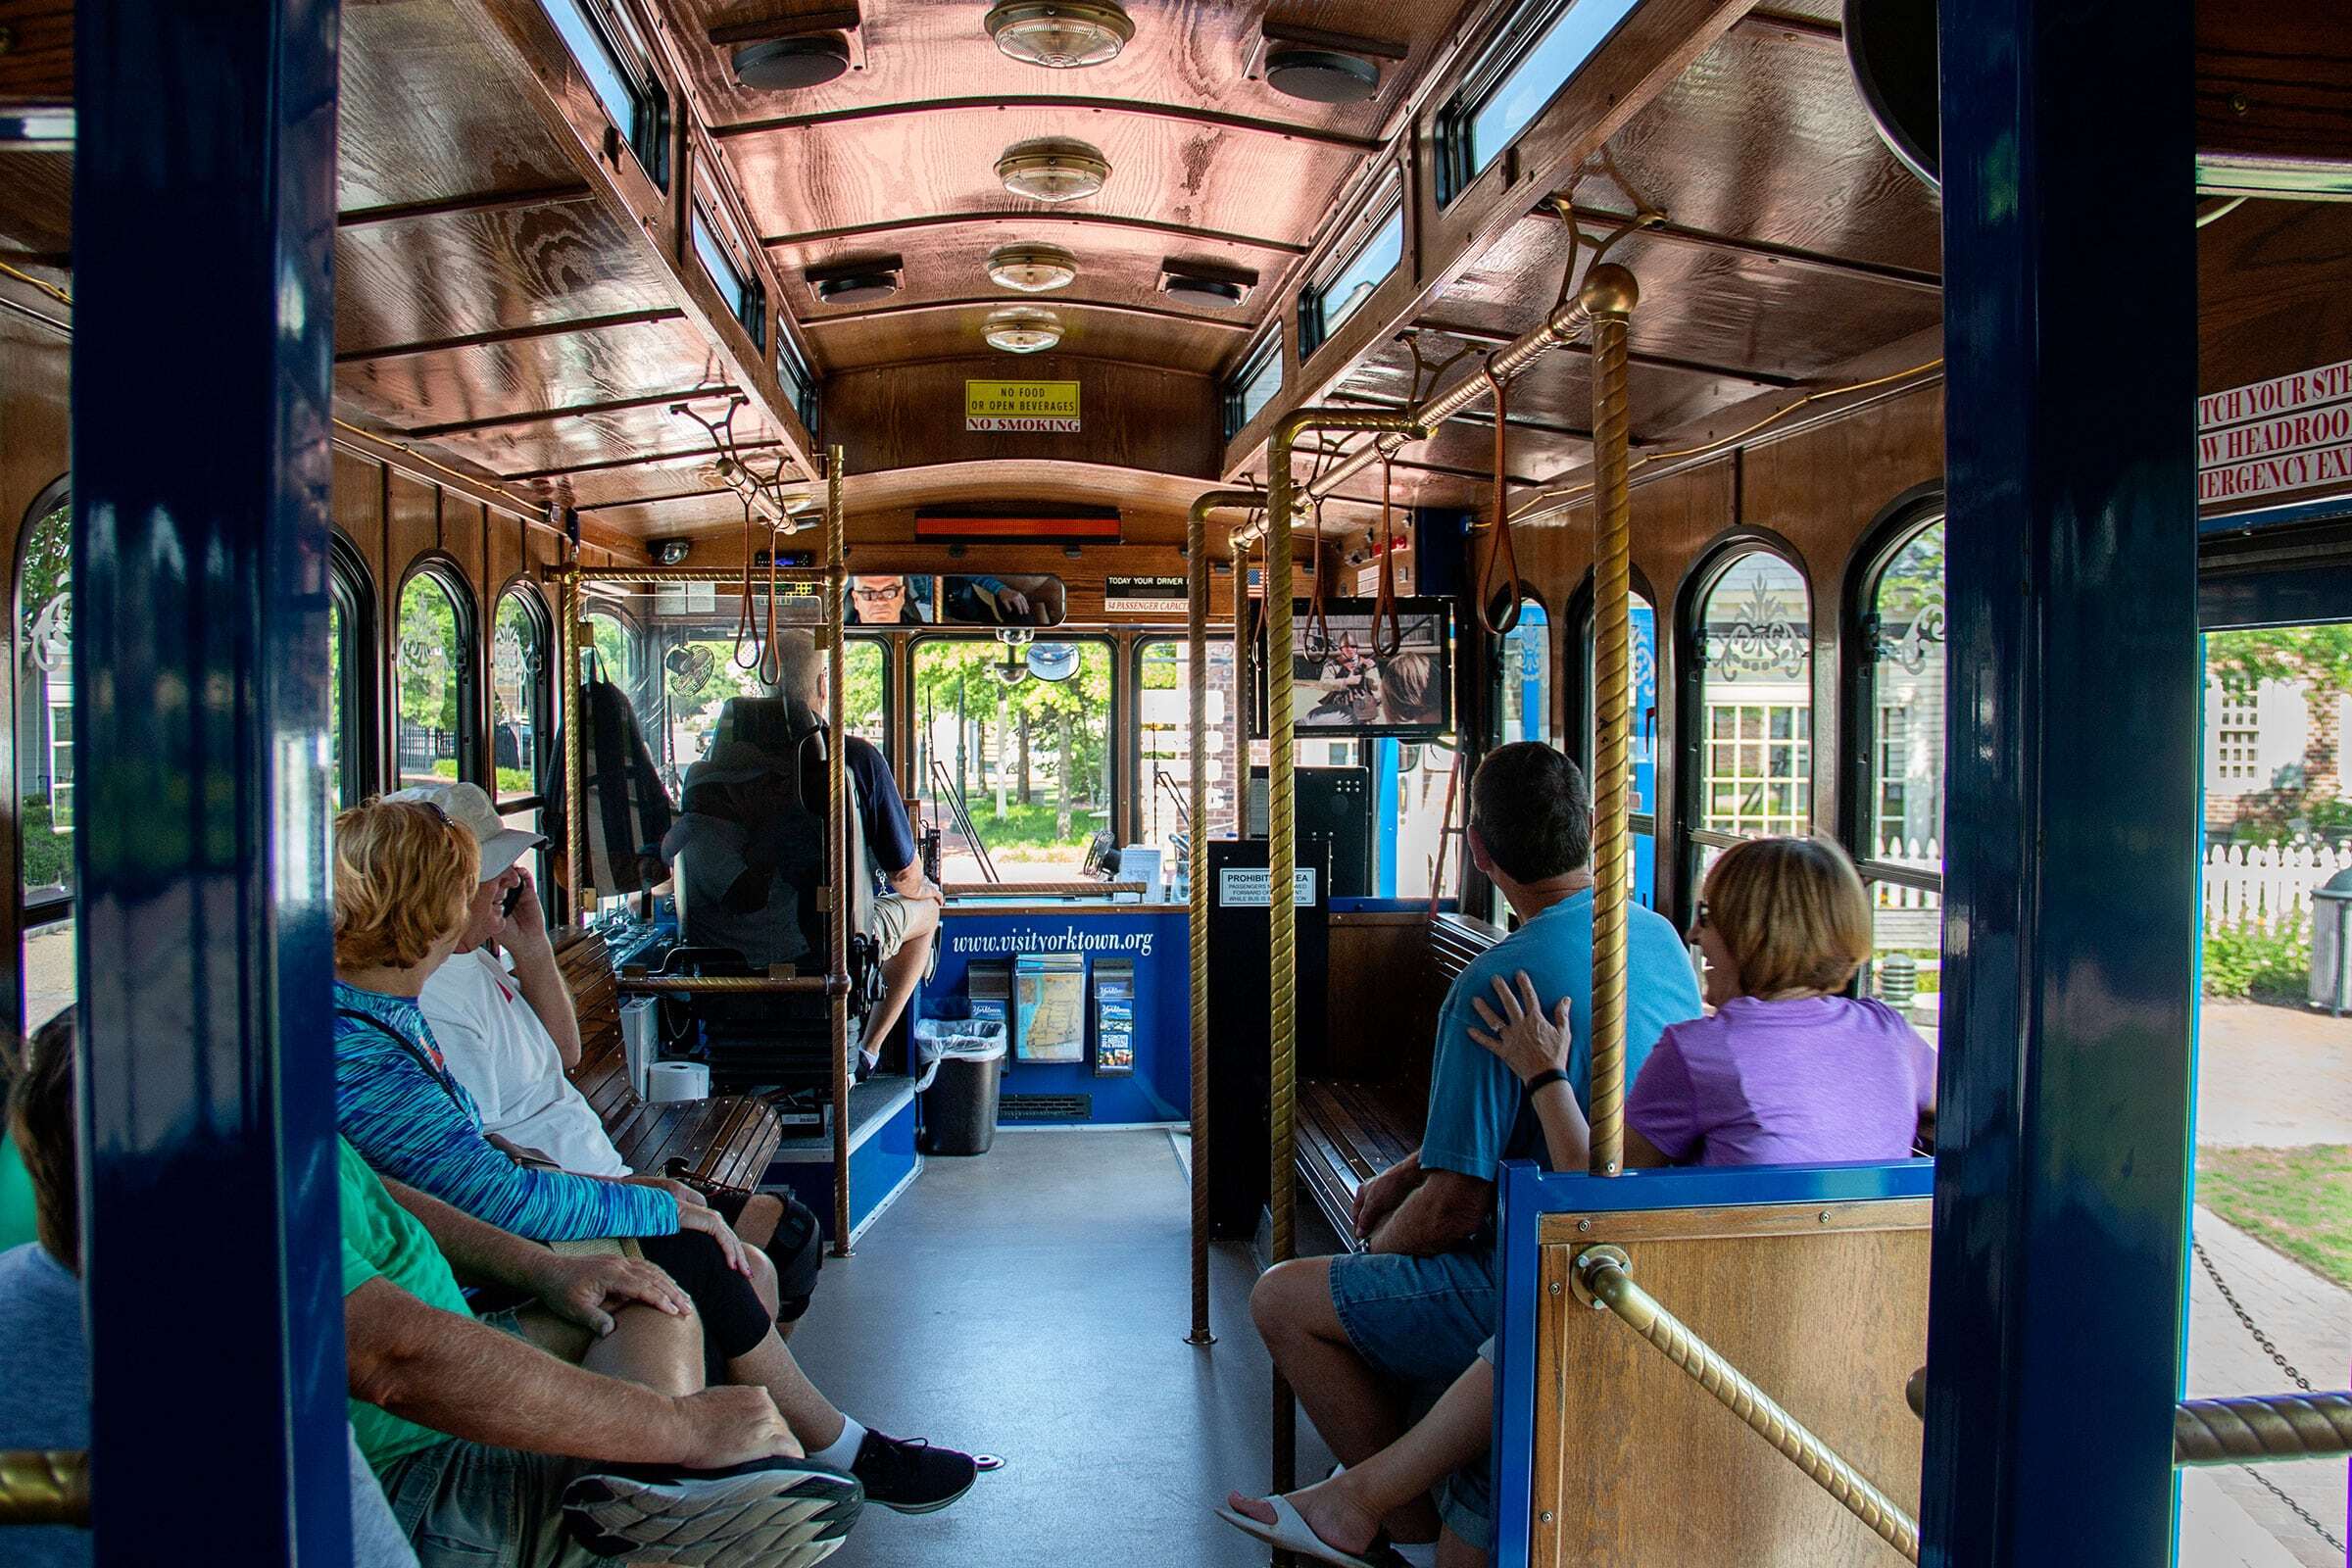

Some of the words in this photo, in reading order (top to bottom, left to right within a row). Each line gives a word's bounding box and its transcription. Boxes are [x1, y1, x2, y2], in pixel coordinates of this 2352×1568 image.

[1001, 388, 1014, 397] NO
[1020, 388, 1045, 398] FOOD
[2198, 390, 2242, 425] TCH
[2246, 375, 2307, 415] YOUR
[972, 401, 984, 410] OR
[989, 401, 1014, 411] OPEN
[1020, 401, 1074, 412] BEVERAGES
[968, 418, 992, 429] NO
[998, 419, 1079, 431] SMOKING
[2226, 406, 2352, 459] HEADROO
[2198, 454, 2312, 499] ERGENCY
[1156, 577, 1184, 586] DRIVER
[1116, 601, 1158, 611] PASSENGER
[1227, 874, 1270, 883] PROHIBIT
[953, 926, 1154, 956] www.visityorktown.org
